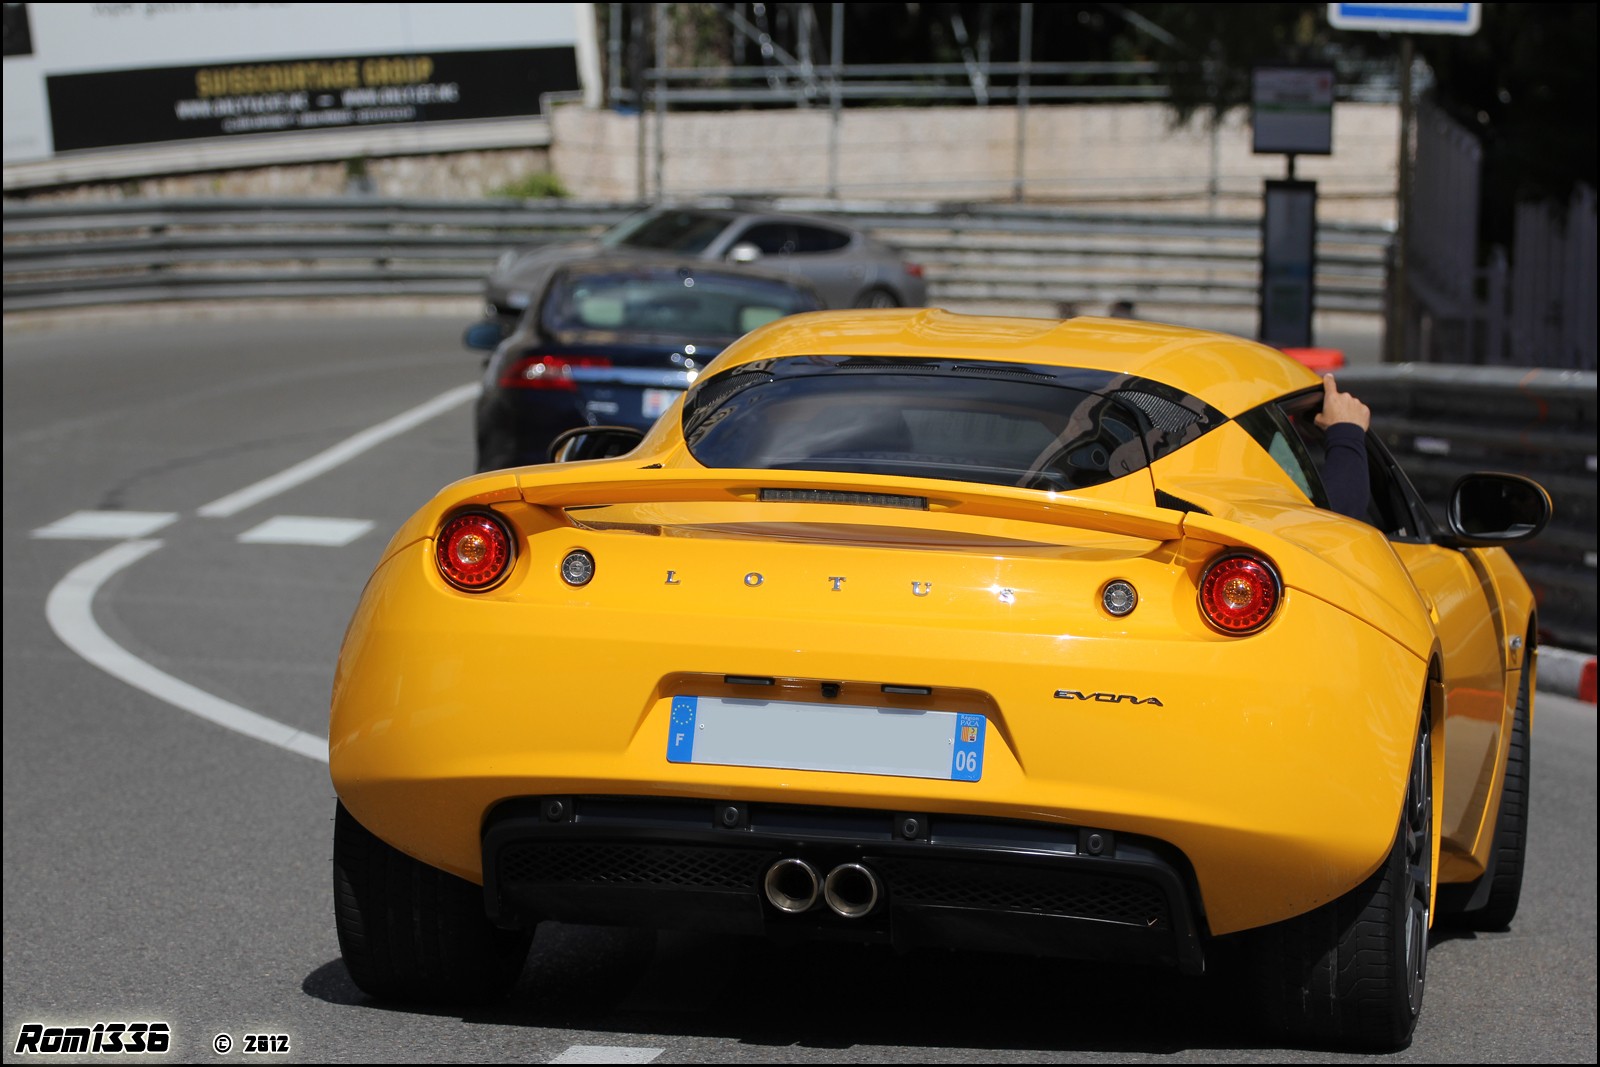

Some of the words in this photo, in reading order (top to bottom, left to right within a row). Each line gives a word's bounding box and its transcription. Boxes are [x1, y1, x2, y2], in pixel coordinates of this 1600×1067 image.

[363, 57, 432, 85] GROUP
[664, 570, 1016, 604] LOTUS
[1053, 689, 1164, 707] EVORA
[675, 732, 685, 747] F
[955, 750, 977, 772] 06
